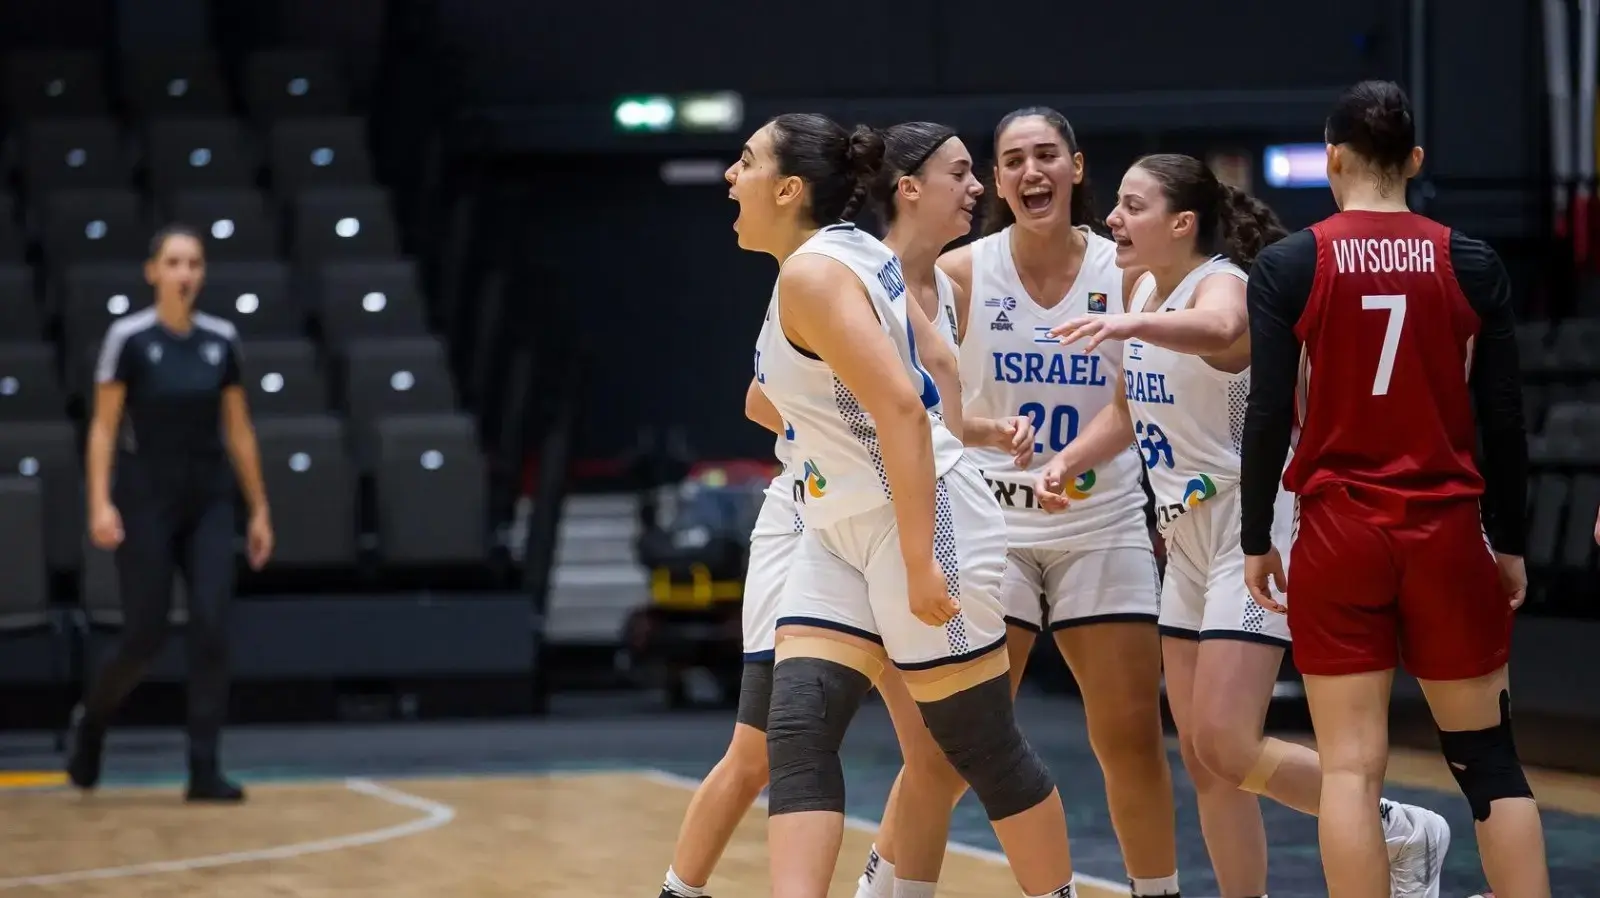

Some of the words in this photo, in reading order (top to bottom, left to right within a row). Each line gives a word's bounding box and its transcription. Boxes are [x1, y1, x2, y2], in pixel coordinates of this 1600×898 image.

[1332, 238, 1435, 273] WYSOCKA
[990, 322, 1014, 331] PEAK
[1361, 294, 1407, 396] 7
[992, 352, 1106, 386] ISRAEL
[1123, 368, 1175, 404] RAEL
[1018, 402, 1079, 453] 20
